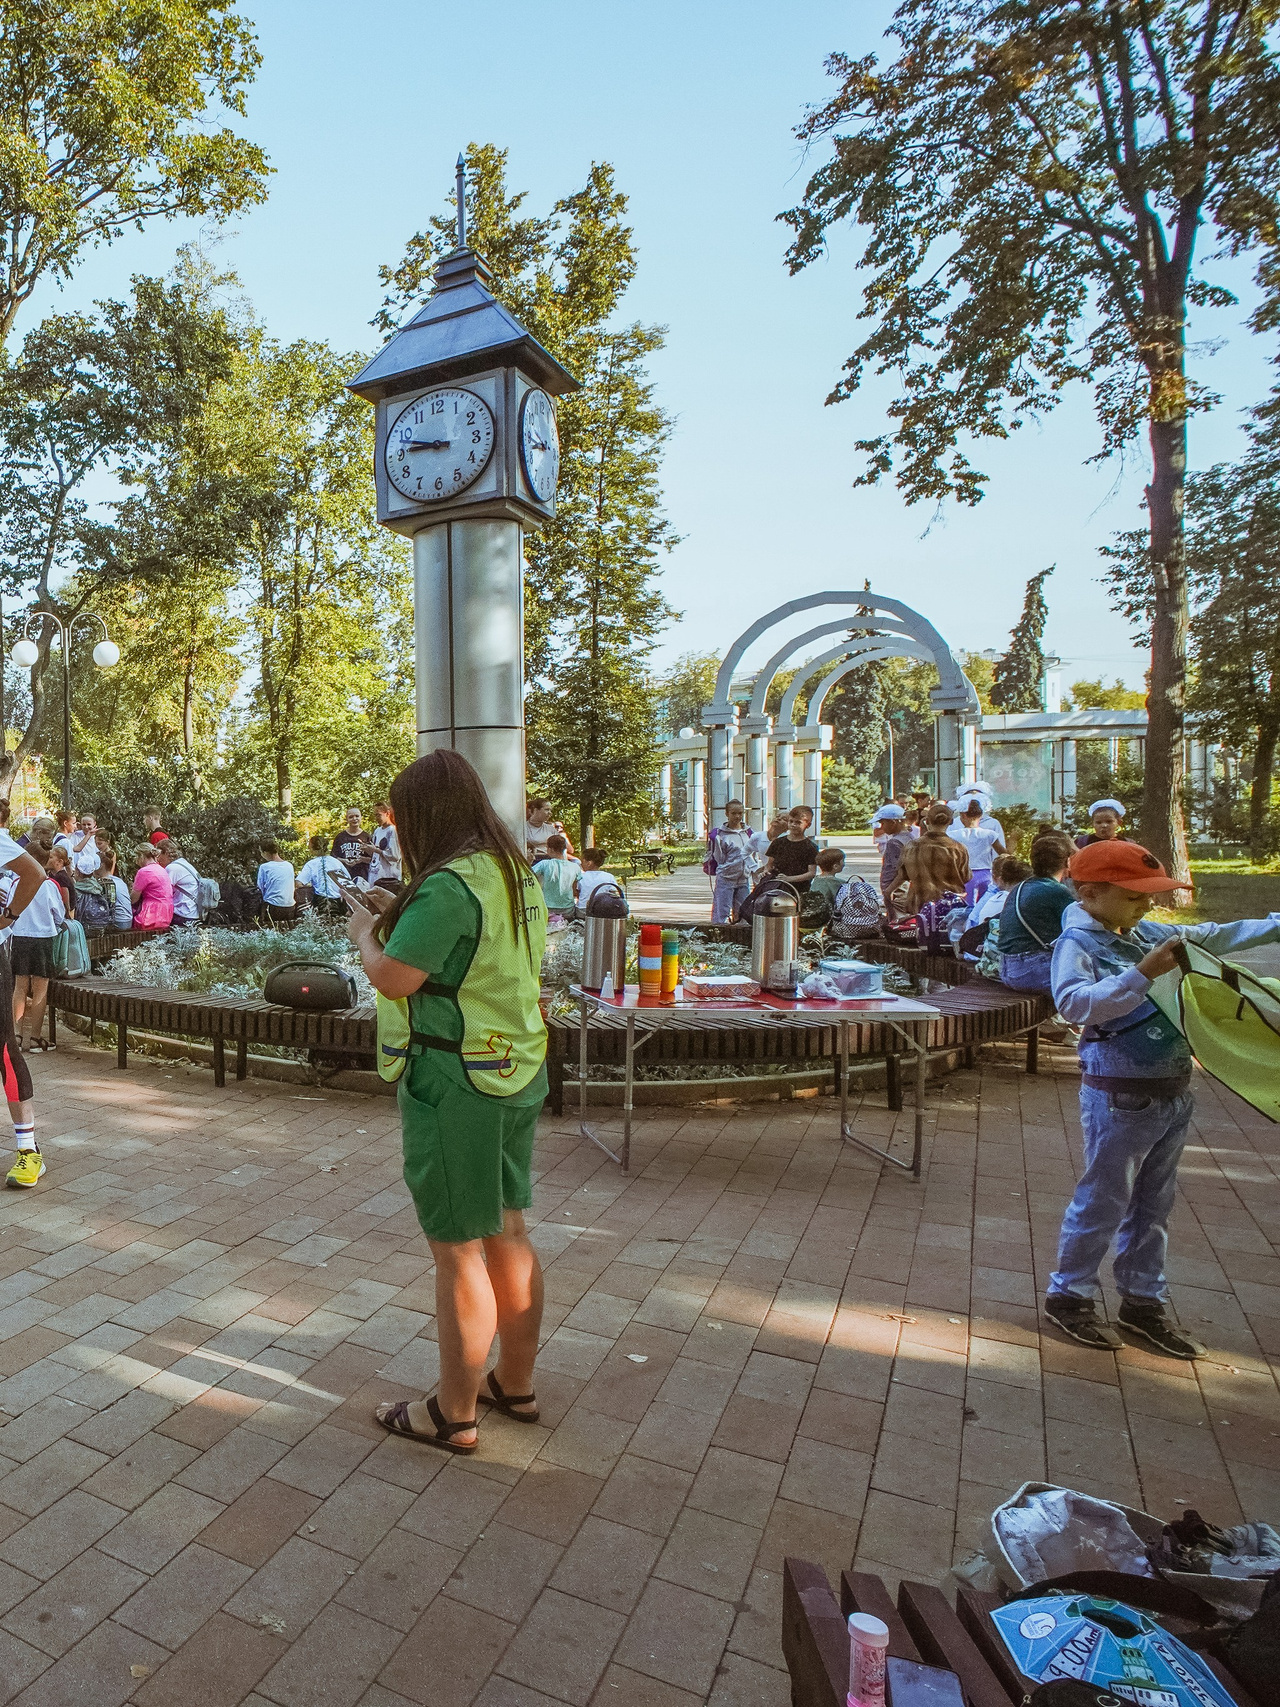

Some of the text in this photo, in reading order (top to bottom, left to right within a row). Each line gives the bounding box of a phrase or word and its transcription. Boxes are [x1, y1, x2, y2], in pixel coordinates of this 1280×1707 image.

[431, 400, 444, 415] 12
[453, 401, 458, 414] 1
[414, 410, 424, 424] 11
[466, 411, 475, 425] 2
[400, 427, 412, 441] 10
[472, 430, 481, 443] 3
[397, 448, 405, 461] 9
[467, 450, 475, 463] 4
[402, 465, 410, 478] 8
[453, 468, 462, 481] 5
[416, 476, 424, 490] 7
[435, 477, 443, 490] 6
